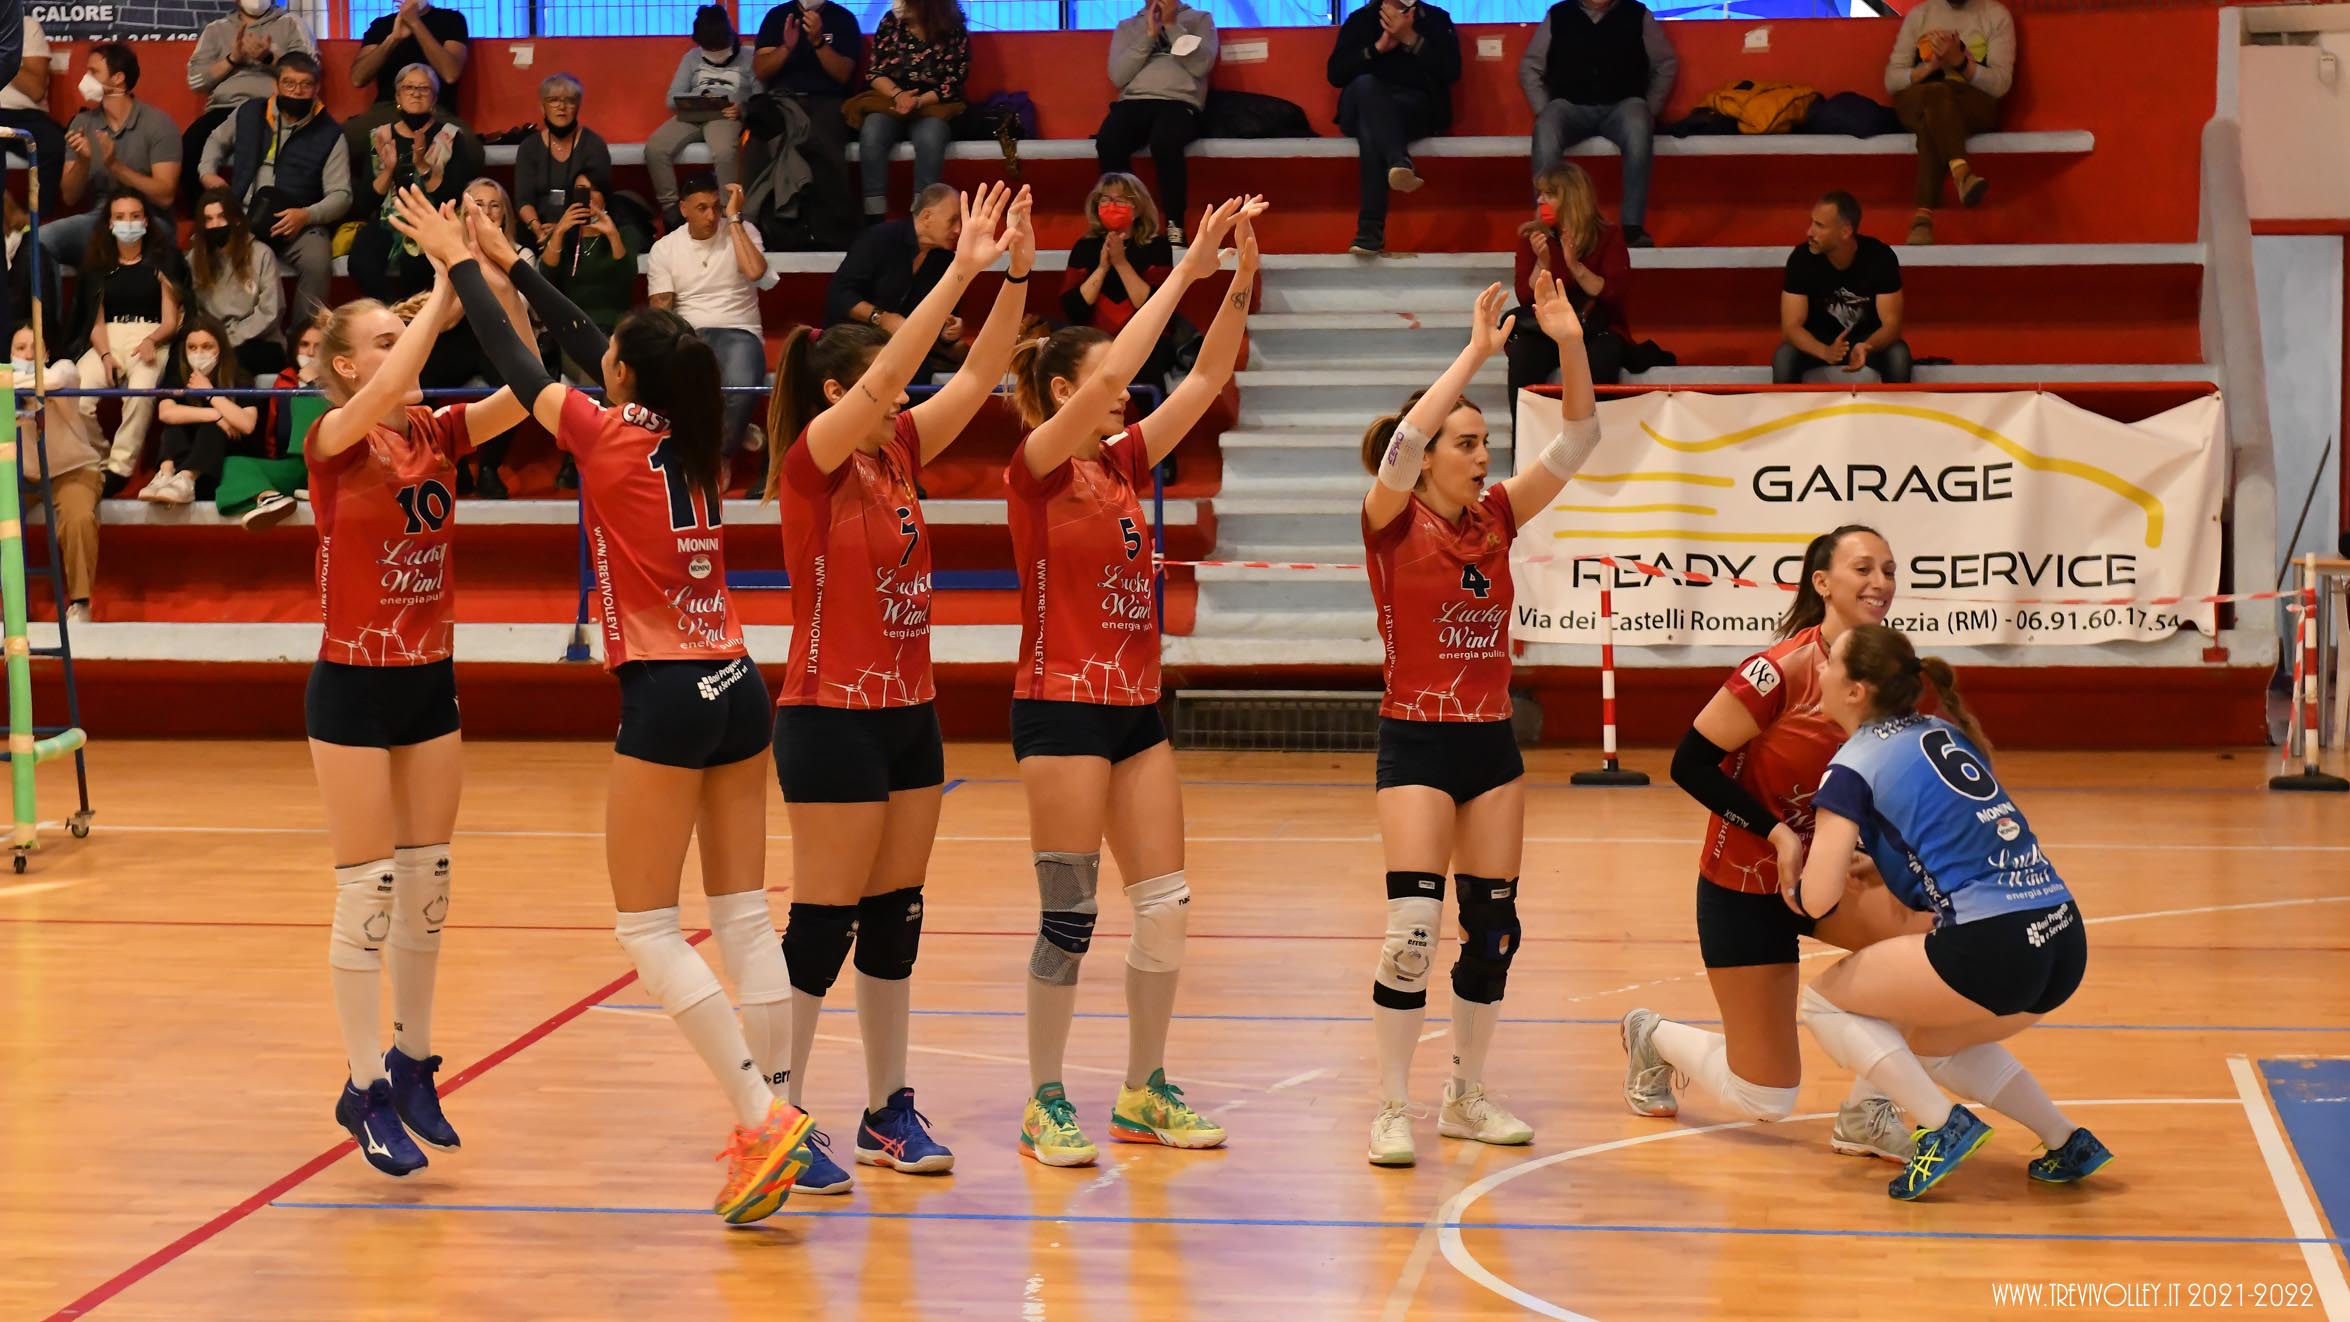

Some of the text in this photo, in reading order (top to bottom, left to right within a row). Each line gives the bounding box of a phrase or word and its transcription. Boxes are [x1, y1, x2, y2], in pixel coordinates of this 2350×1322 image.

[32, 5, 114, 22] CALORE
[1752, 462, 2013, 502] GARAGE
[395, 479, 452, 534] 10
[677, 537, 719, 553] MONINI
[1119, 516, 1142, 561] 5
[593, 526, 621, 641] WWW.TREVIVOLLEY.IT
[690, 564, 710, 573] MONINI
[1460, 563, 1491, 598] 4
[1911, 551, 2136, 589] SERVICE
[1433, 600, 1508, 630] Lucky
[1519, 606, 1551, 628] Via
[1559, 611, 1596, 629] dei
[1948, 608, 1998, 634] (RM)
[1438, 626, 1499, 649] Wind
[1438, 651, 1479, 660] energia
[1920, 727, 1999, 801] 6
